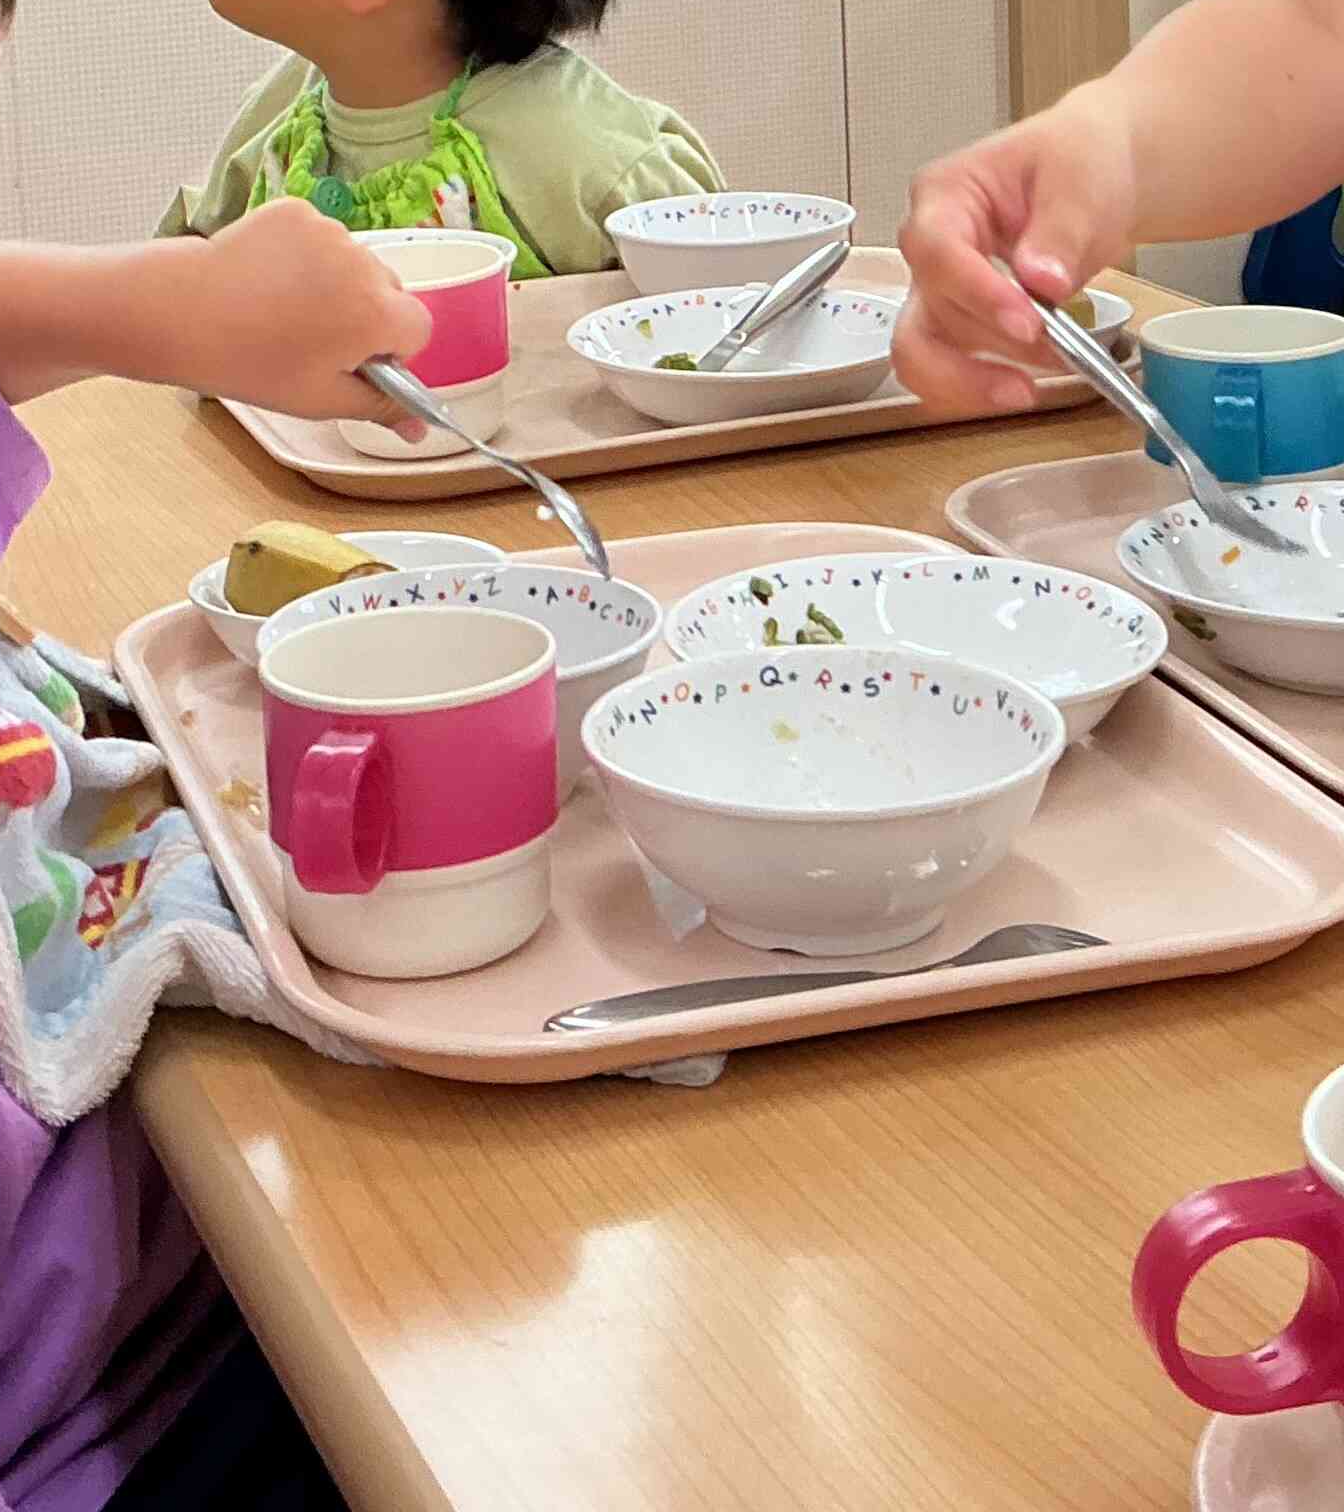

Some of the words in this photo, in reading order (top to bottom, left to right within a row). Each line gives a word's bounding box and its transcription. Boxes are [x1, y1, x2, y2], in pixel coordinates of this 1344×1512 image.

[716, 683, 728, 704] P
[760, 666, 784, 687] Q
[864, 677, 881, 698] S
[910, 671, 927, 691] T
[953, 694, 969, 716] U
